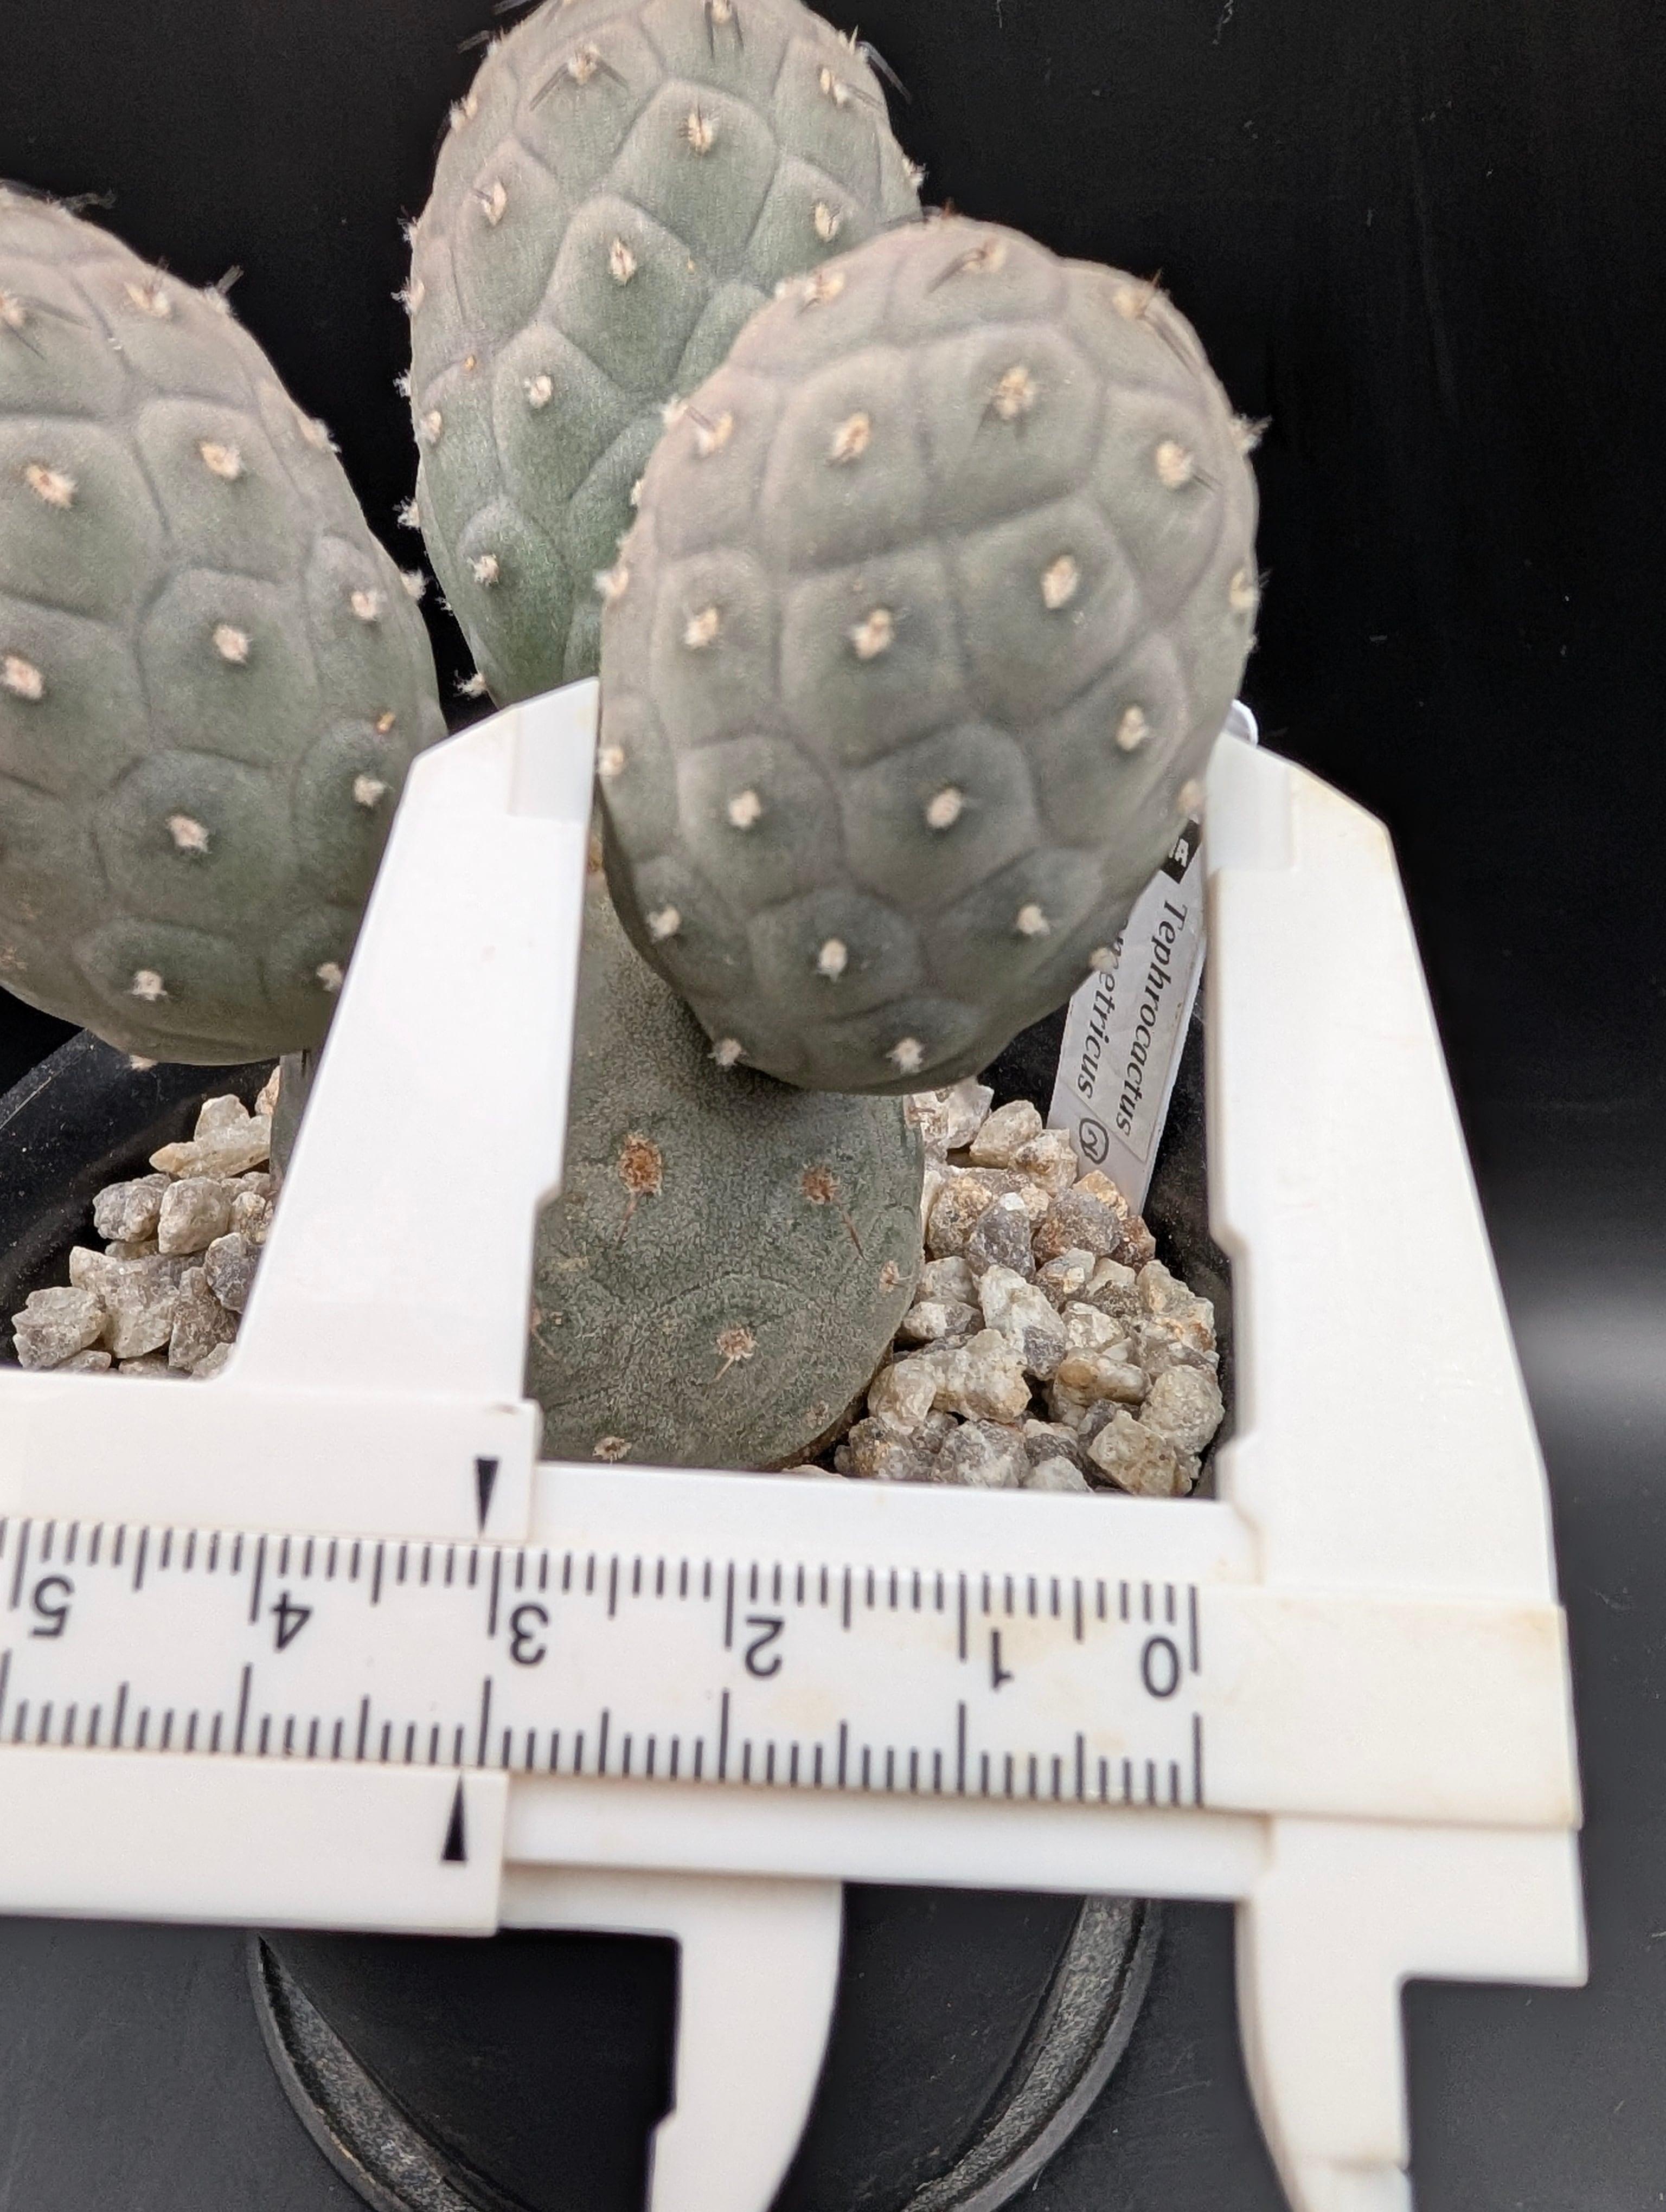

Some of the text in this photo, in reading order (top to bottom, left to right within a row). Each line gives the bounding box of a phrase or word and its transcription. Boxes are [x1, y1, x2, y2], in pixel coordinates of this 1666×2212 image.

[1116, 900, 1188, 1137] Tephrocactus
[29, 1575, 1181, 1699] 0 1 2 3 4 5
